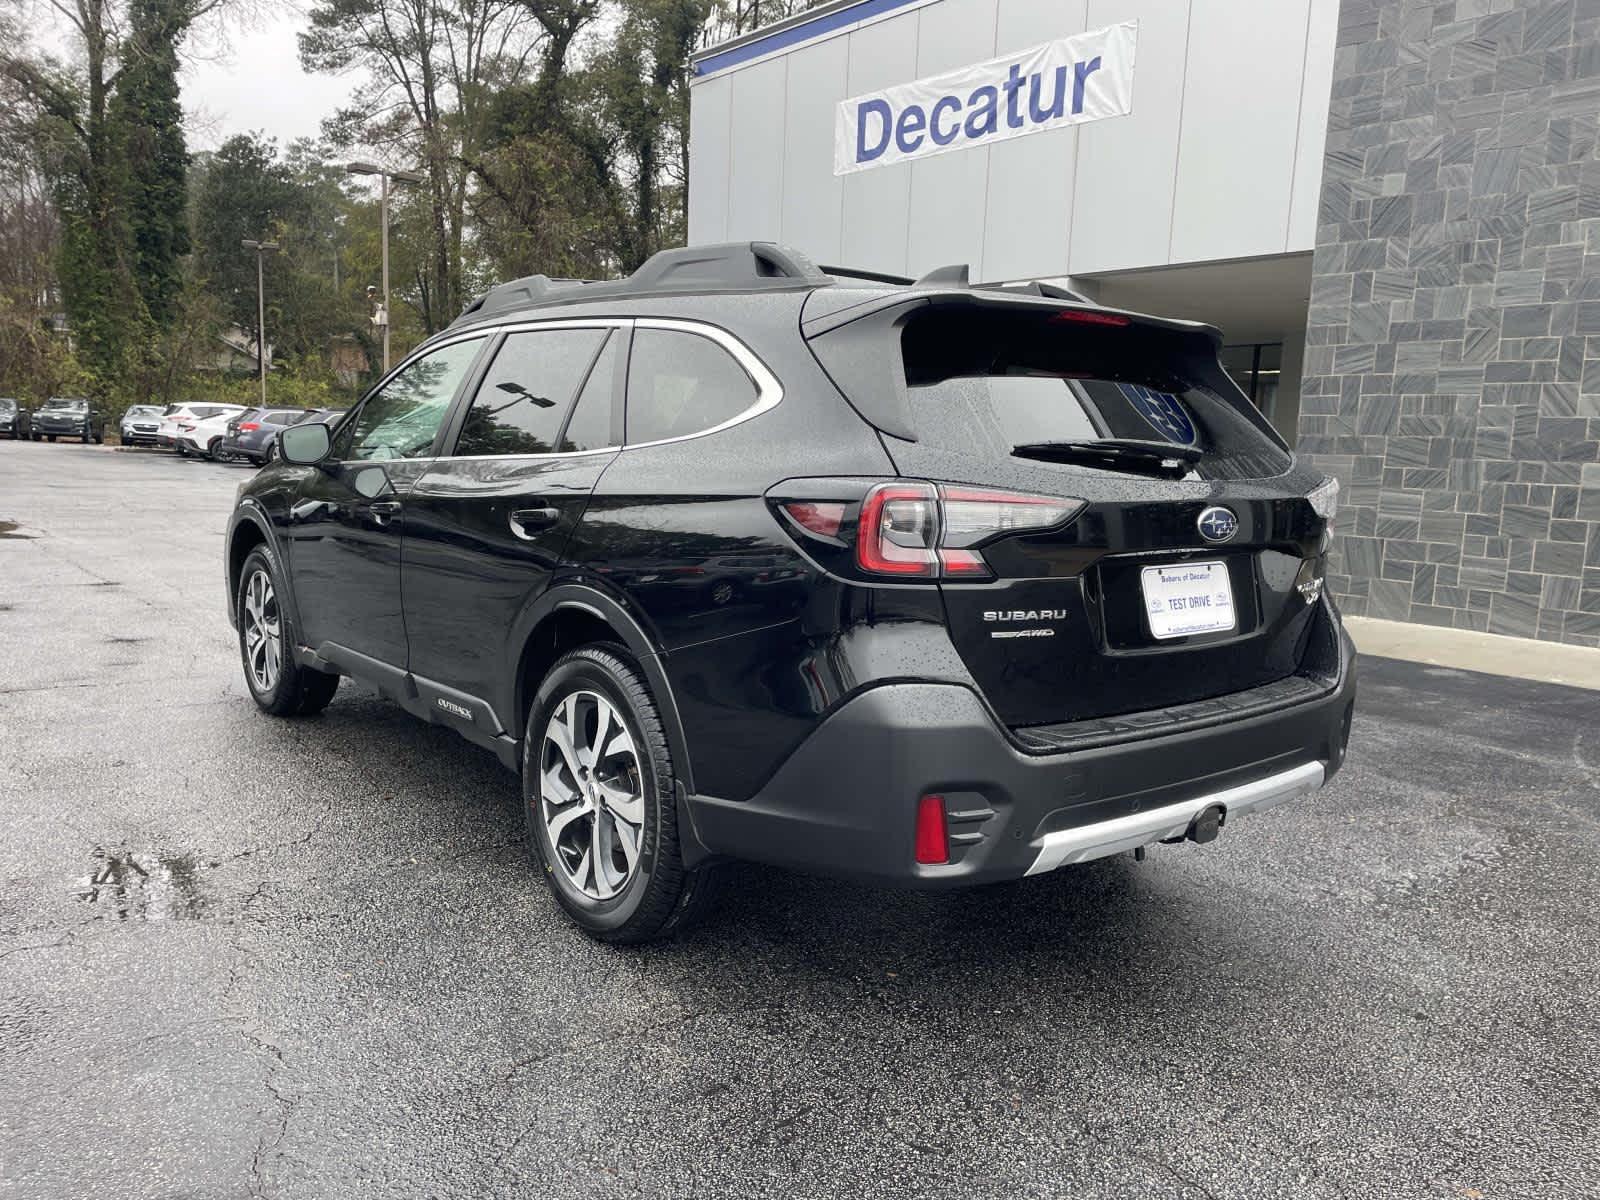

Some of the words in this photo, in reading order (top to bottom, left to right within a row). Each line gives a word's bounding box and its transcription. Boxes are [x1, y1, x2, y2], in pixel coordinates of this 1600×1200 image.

[856, 55, 1102, 164] Decatur
[1168, 598, 1187, 611] TEST
[1189, 595, 1212, 609] DRIVE
[983, 609, 1067, 621] SUBARU
[1013, 628, 1055, 638] AWD
[438, 698, 472, 719] OUTBACK
